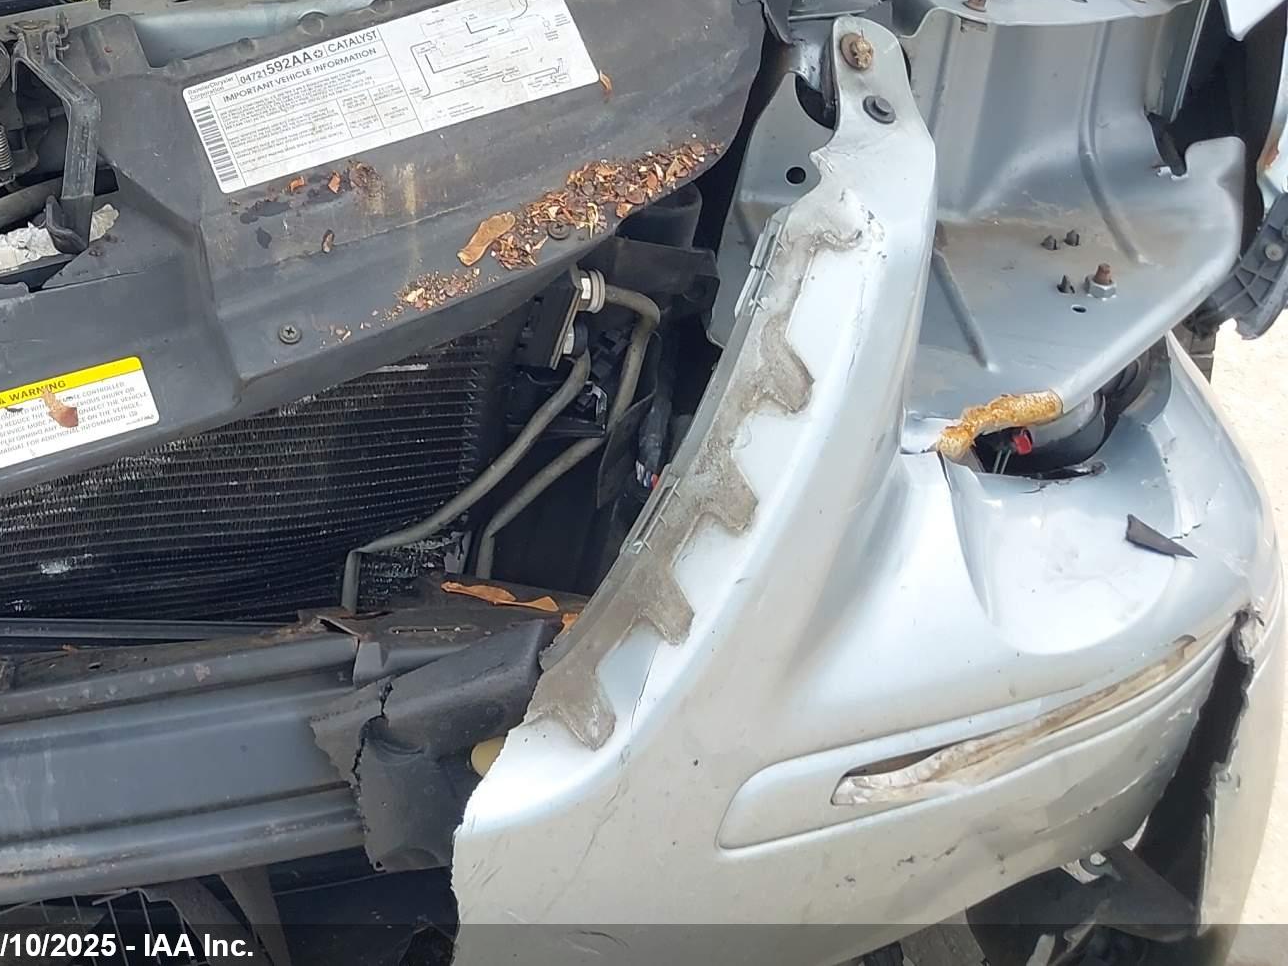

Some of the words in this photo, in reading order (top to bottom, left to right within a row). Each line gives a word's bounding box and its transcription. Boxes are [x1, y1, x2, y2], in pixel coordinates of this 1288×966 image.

[221, 79, 274, 102] IMPORTANT
[274, 67, 312, 85] VEHICLE
[312, 46, 377, 73] INFORMATION
[237, 49, 313, 83] 04721592AA
[326, 29, 378, 53] CATALYST
